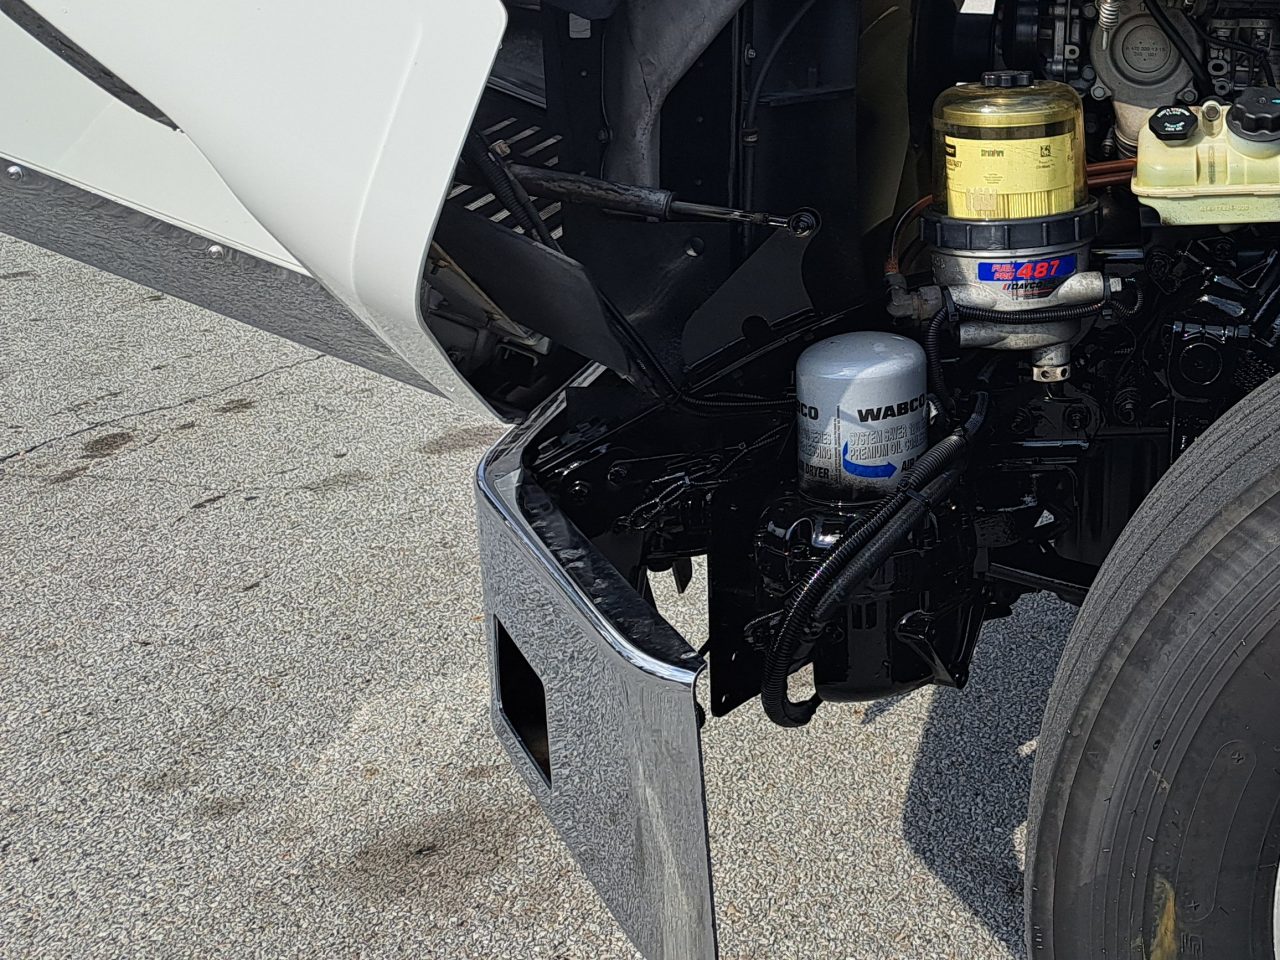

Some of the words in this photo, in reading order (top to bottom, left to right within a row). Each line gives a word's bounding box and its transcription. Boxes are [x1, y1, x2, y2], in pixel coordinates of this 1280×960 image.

[991, 263, 1016, 272] FUEL
[1016, 259, 1060, 279] 487
[993, 272, 1015, 281] PRO
[857, 392, 926, 423] WABCO
[849, 429, 882, 447] SYSTEM
[883, 424, 908, 441] SAVER
[850, 442, 889, 461] PREMIUM
[891, 439, 903, 455] OIL
[805, 463, 830, 480] DRYER
